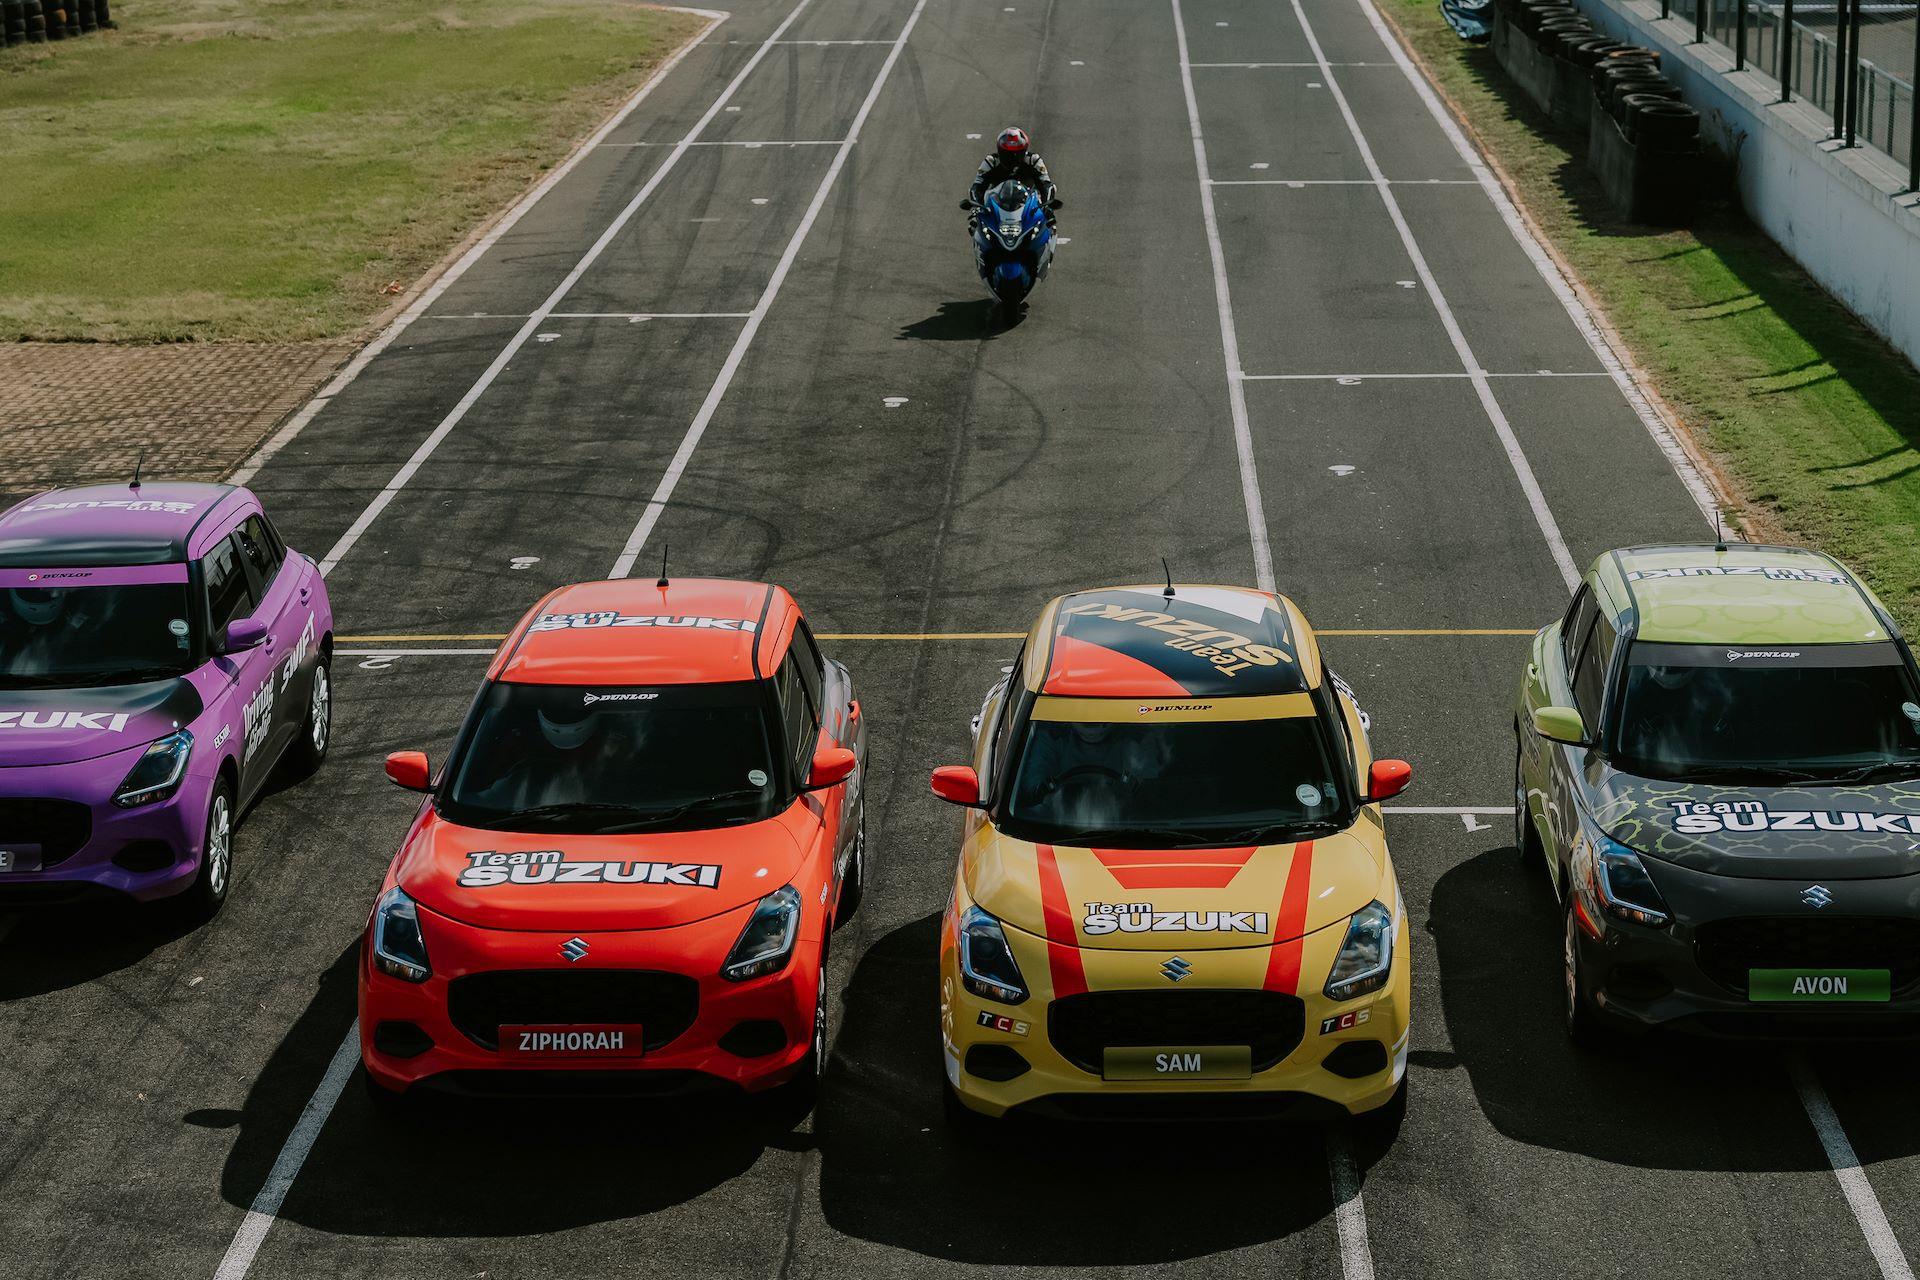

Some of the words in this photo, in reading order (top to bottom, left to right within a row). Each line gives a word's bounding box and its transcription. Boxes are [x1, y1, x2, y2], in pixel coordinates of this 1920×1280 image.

[21, 500, 197, 513] SUZUKI
[527, 616, 758, 633] SUZUKI
[1061, 602, 1294, 666] SUZUKI
[280, 610, 316, 694] SWIFT
[1164, 637, 1253, 678] Team
[599, 693, 659, 701] DUNLOP
[1154, 704, 1213, 712] DUNLOP
[1670, 800, 1766, 816] Team
[468, 850, 562, 867] Team
[458, 861, 721, 889] SUZUKI
[1084, 902, 1153, 915] Team
[1083, 911, 1268, 935] SUZUKI
[1791, 976, 1848, 994] AVON
[980, 1011, 1029, 1035] TCS
[1322, 1008, 1371, 1033] TCS
[518, 1030, 625, 1052] ZIPHORAH
[1155, 1053, 1202, 1072] SAM
